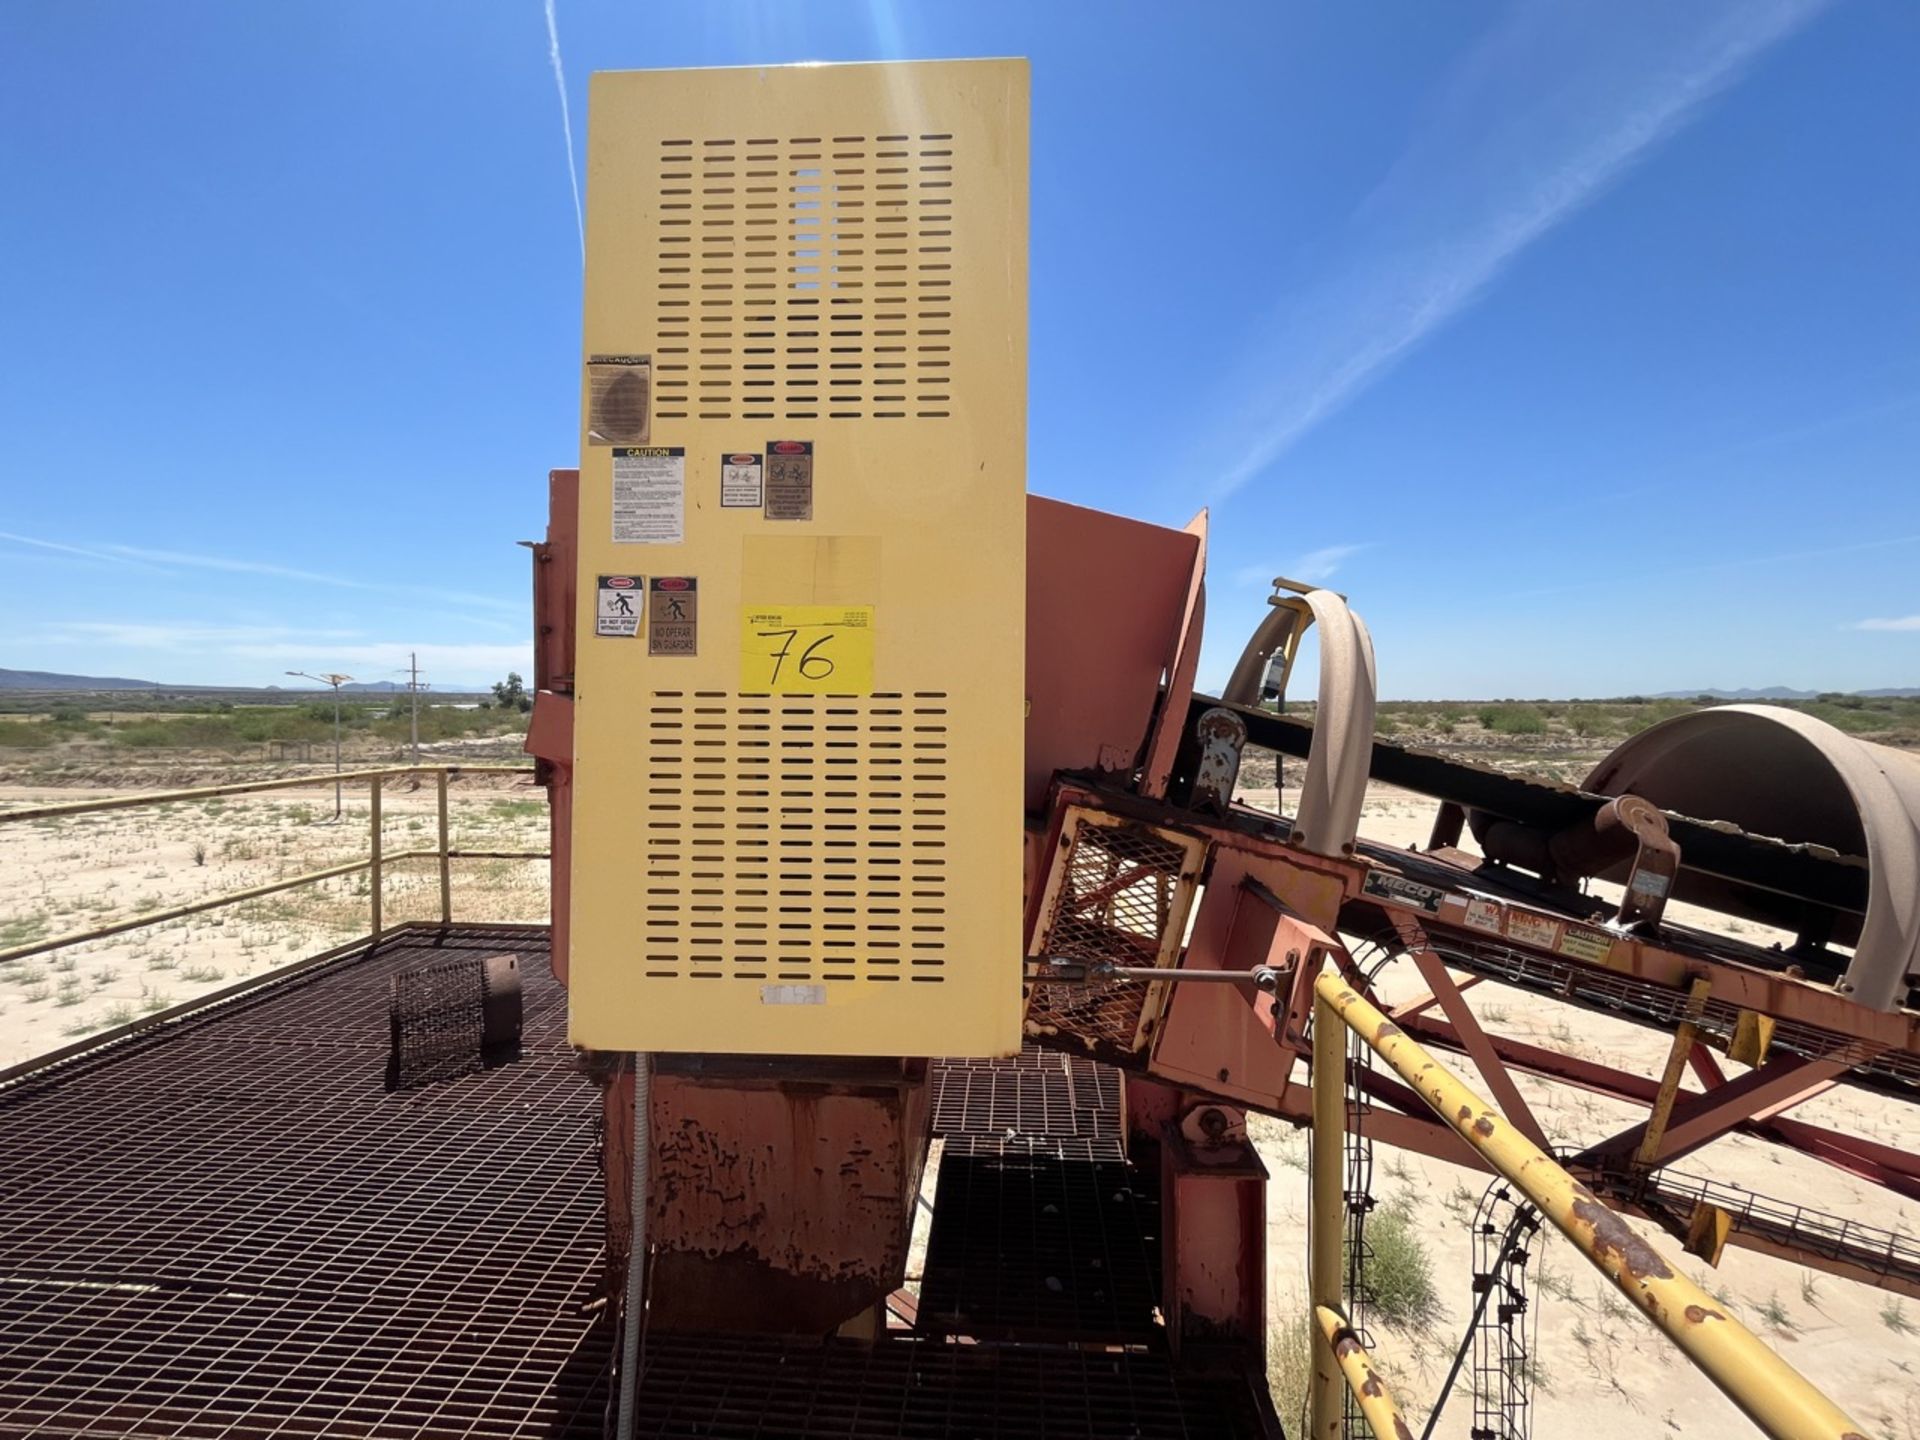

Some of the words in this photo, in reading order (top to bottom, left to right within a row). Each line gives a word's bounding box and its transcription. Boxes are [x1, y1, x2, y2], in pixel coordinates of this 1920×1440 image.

[626, 449, 670, 457] CAUTION
[757, 629, 834, 685] 76
[1377, 875, 1433, 898] MECO
[1568, 929, 1610, 946] CAUTION
